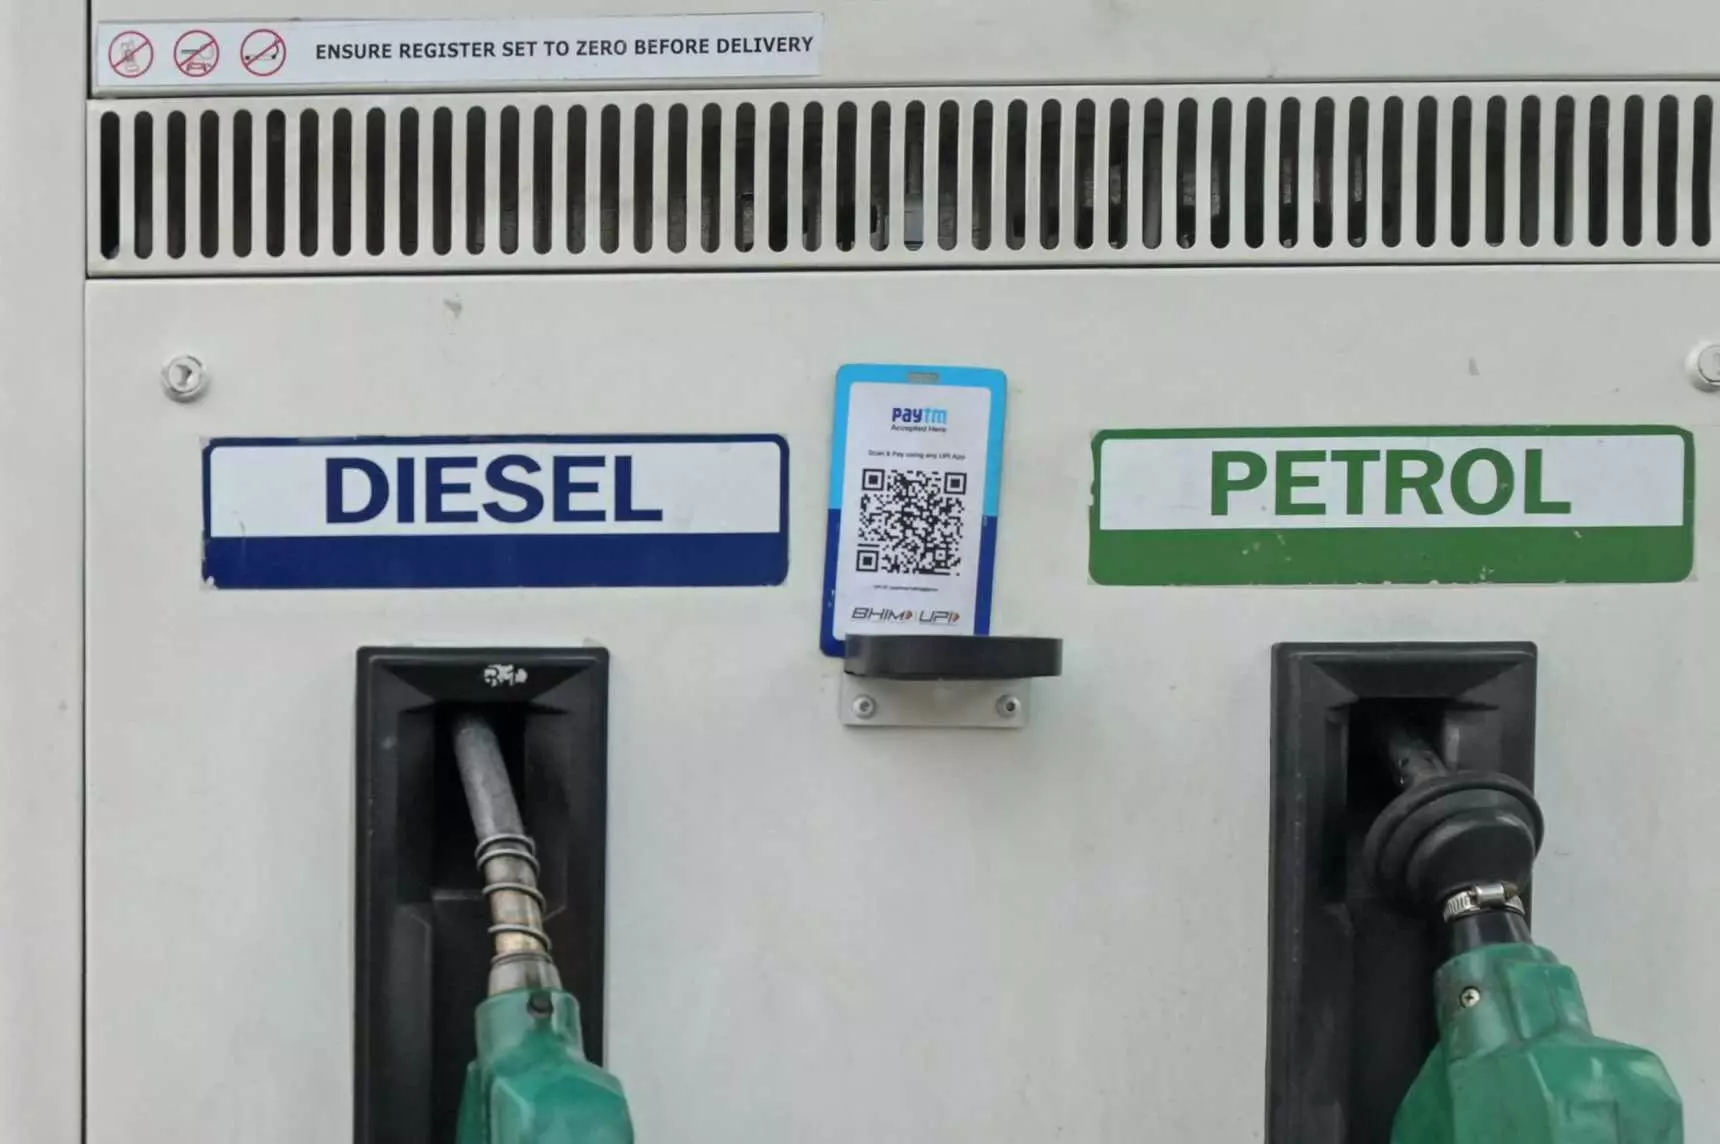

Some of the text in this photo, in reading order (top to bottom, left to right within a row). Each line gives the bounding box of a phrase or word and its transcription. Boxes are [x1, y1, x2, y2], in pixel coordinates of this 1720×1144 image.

[315, 36, 814, 60] ENSURE REGISTER SET TO ZERO BEFORE DELIVERY
[325, 454, 664, 525] DIESEL
[1210, 447, 1572, 516] PETROL
[851, 606, 954, 623] BHIM UPI
